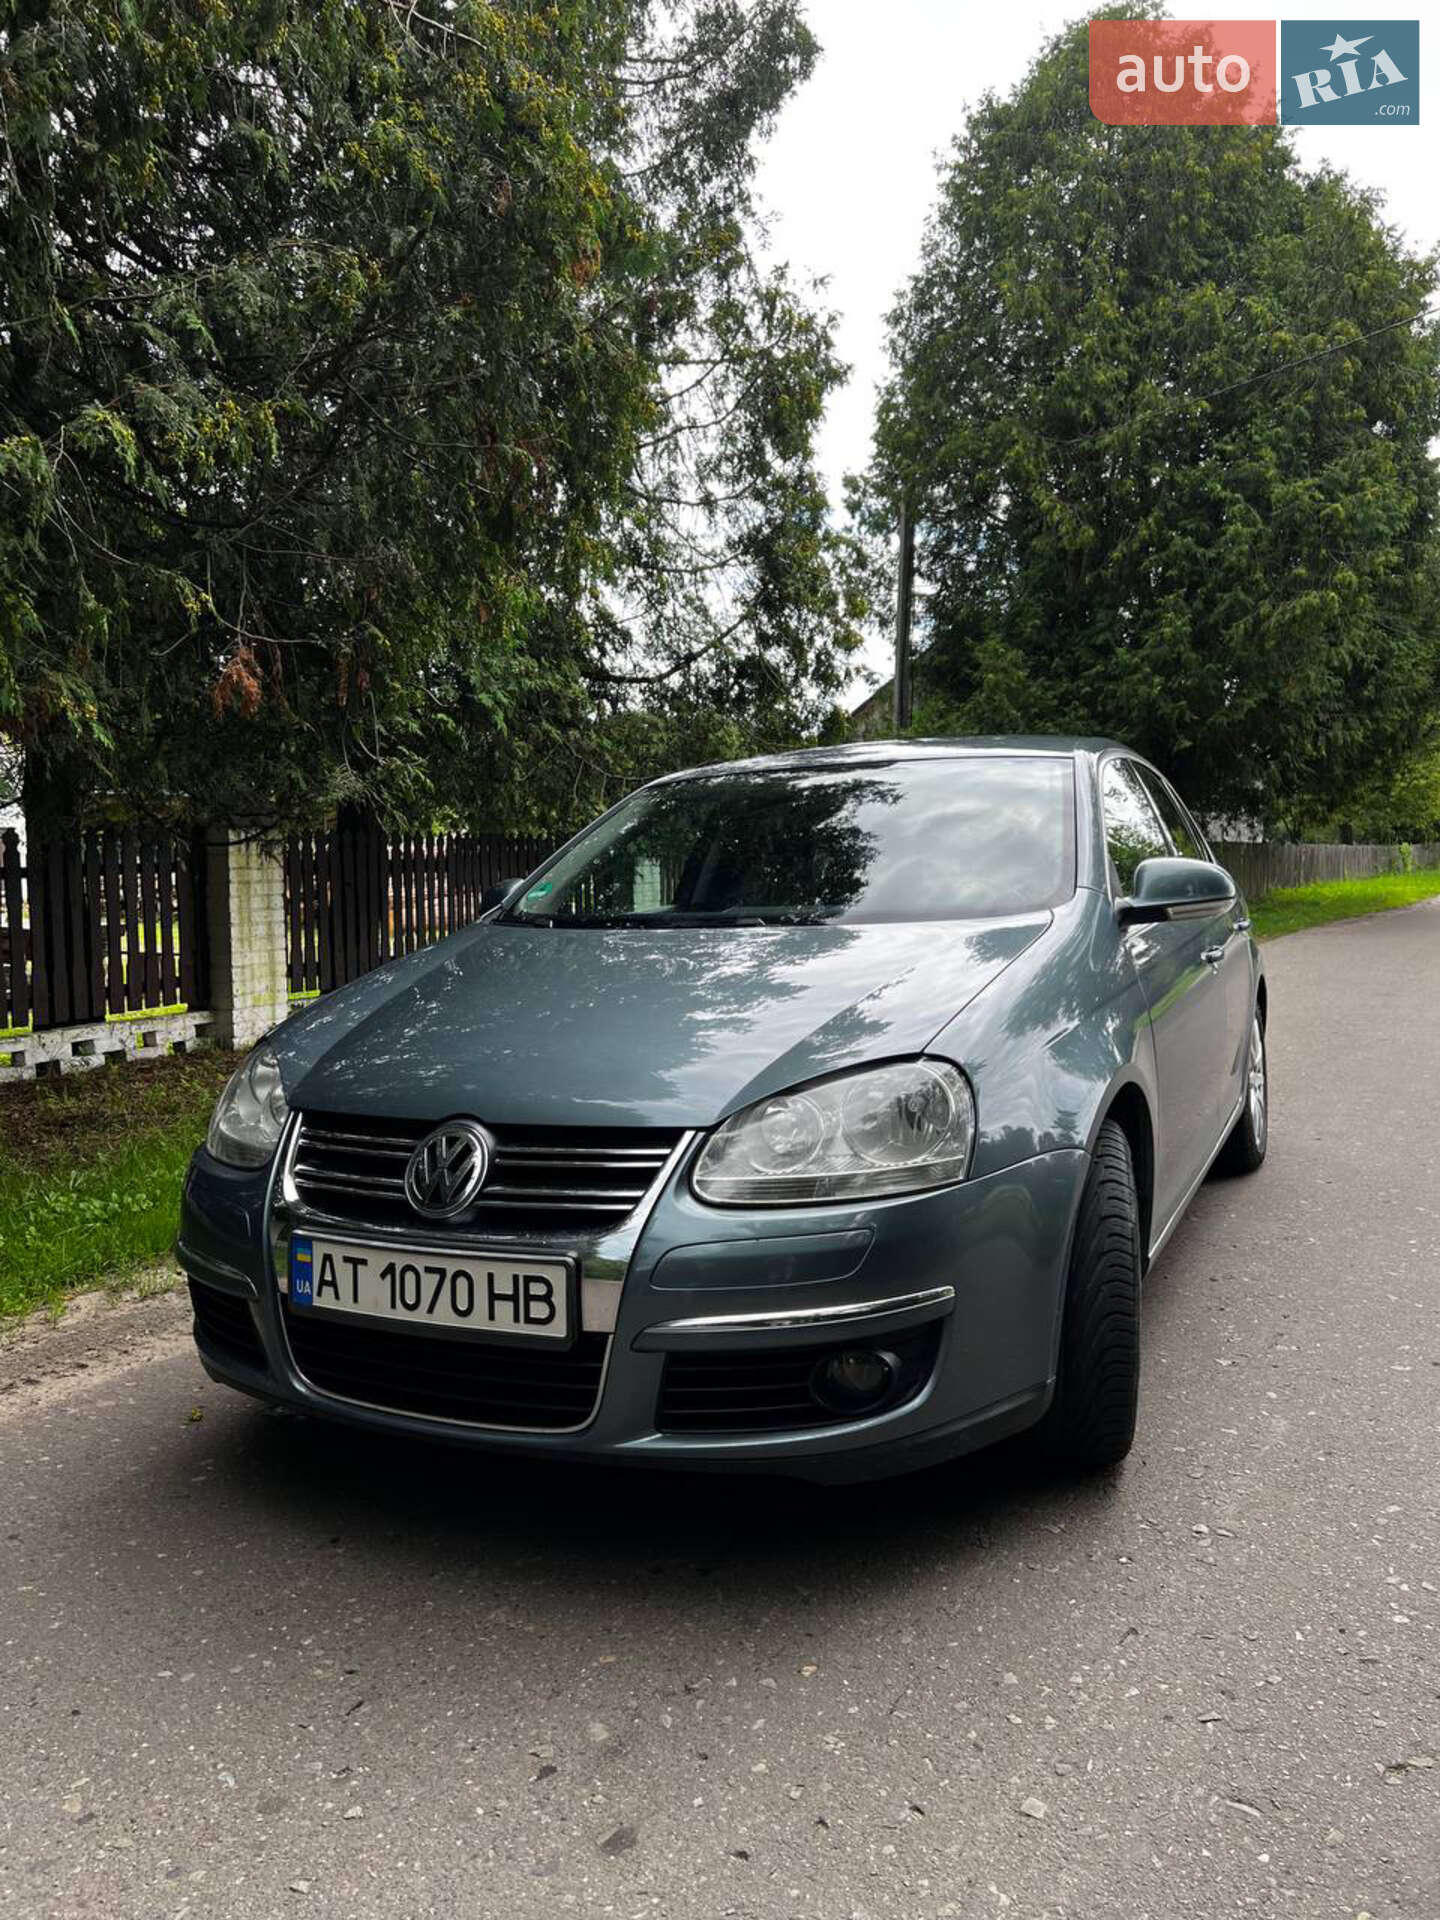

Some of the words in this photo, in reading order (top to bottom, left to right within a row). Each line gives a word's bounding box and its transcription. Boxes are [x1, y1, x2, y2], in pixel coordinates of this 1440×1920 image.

[407, 1121, 484, 1215] VW
[296, 1279, 312, 1296] UA
[316, 1252, 368, 1304] AT
[379, 1261, 475, 1318] 1070
[487, 1271, 557, 1326] HB
